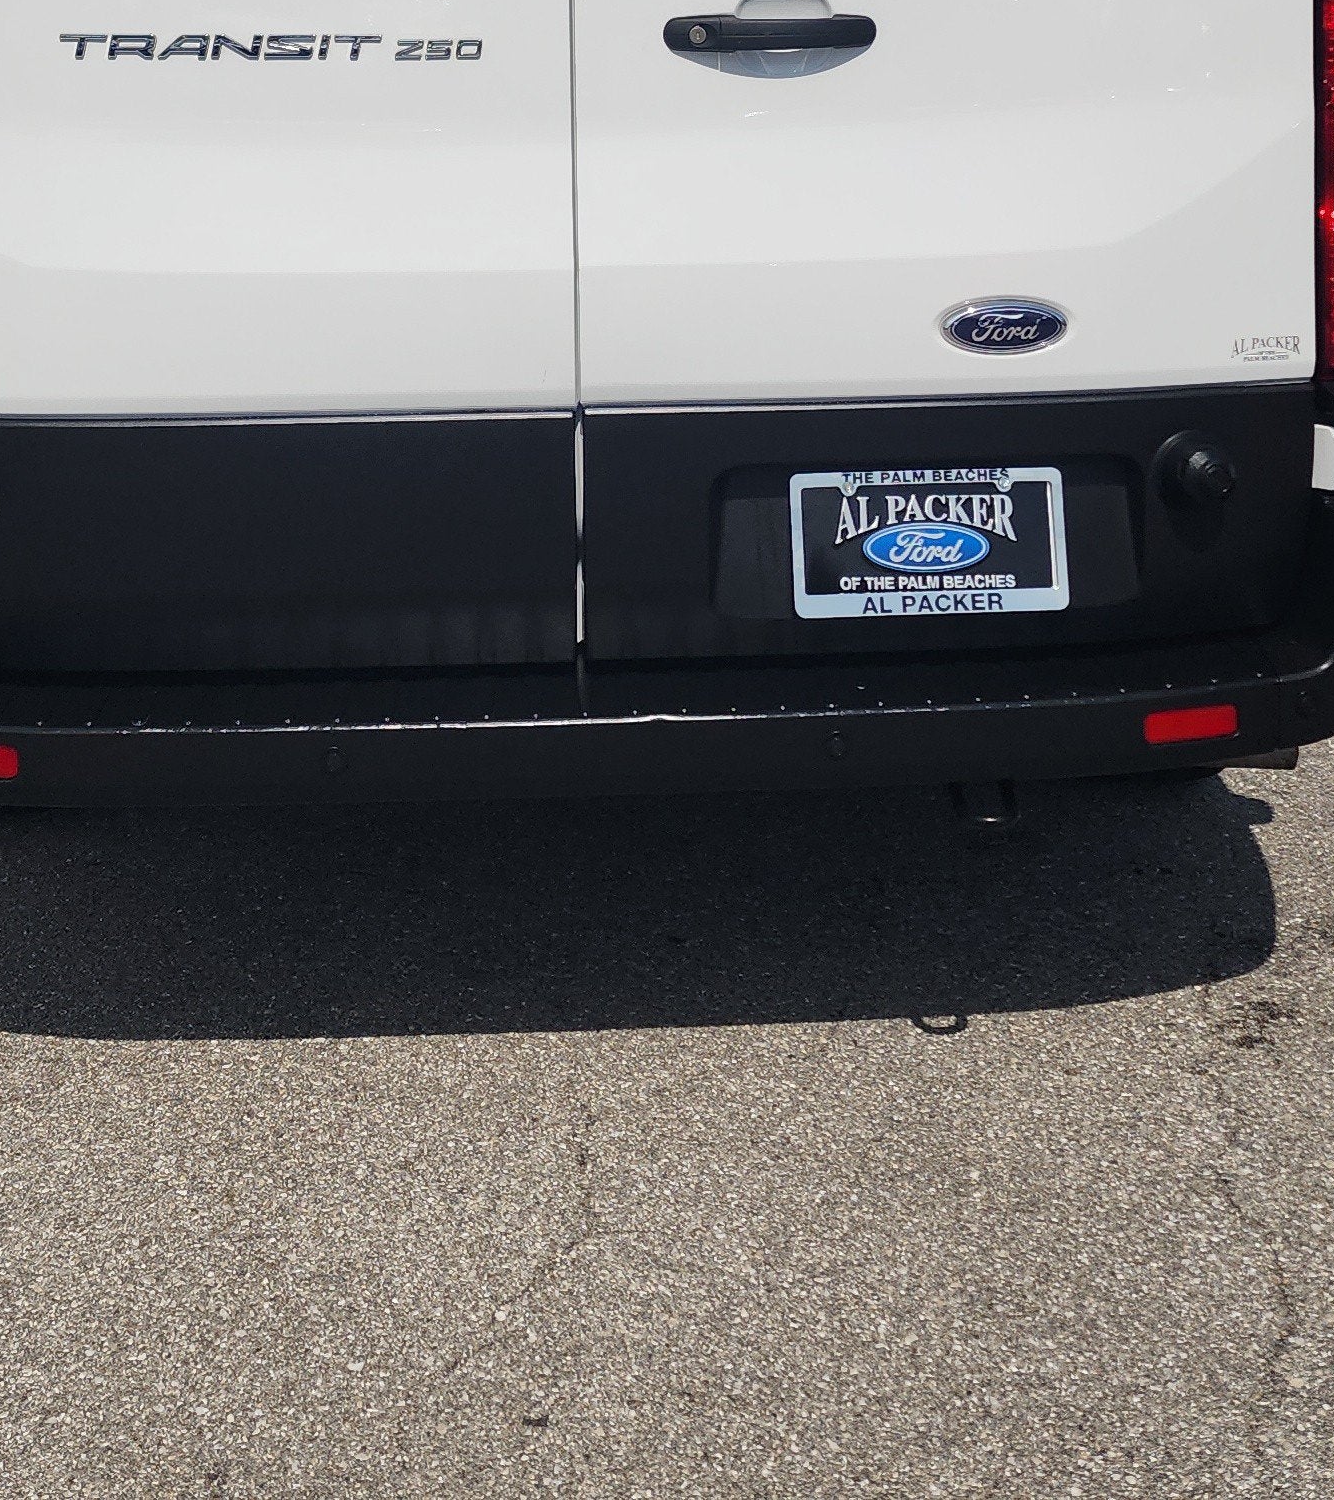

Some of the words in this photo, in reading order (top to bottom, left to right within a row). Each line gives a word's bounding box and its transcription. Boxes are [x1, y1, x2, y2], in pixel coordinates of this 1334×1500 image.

[59, 33, 382, 62] TRANSIT
[394, 38, 483, 62] 250
[971, 312, 1041, 343] Ford
[1231, 339, 1249, 359] AL
[1251, 335, 1301, 355] PACKER
[842, 471, 874, 484] THE
[881, 470, 926, 484] PALM
[932, 468, 1009, 482] BEACHES
[834, 496, 879, 545] AL
[885, 493, 1018, 542] PACKER
[888, 530, 965, 564] Ford
[839, 576, 862, 591] OF
[864, 575, 895, 591] THE
[898, 574, 940, 590] PALM
[943, 573, 1017, 589] BEACHES
[862, 596, 893, 615] AL
[901, 592, 1004, 613] PACKER
